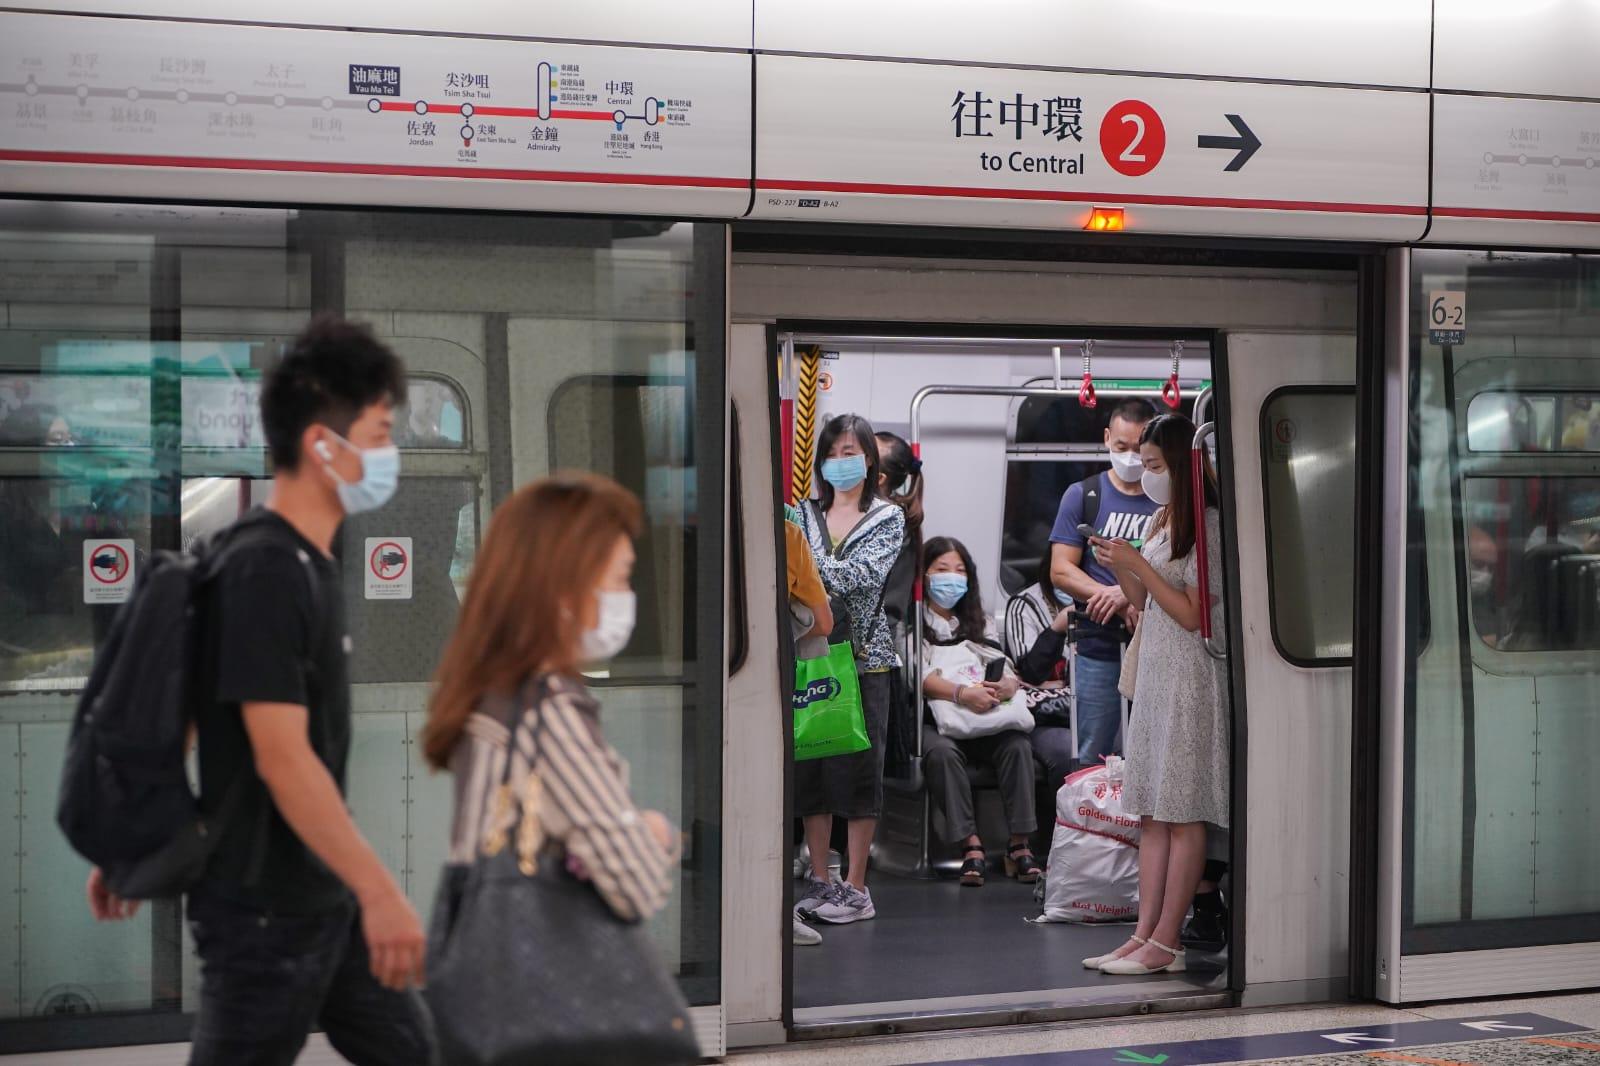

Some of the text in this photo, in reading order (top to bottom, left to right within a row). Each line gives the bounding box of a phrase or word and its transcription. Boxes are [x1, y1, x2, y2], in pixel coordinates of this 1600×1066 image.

[265, 63, 296, 79] 太子
[352, 67, 398, 85] 油麻地
[445, 72, 490, 88] 尖沙咀
[605, 80, 634, 95] 中環
[355, 85, 394, 94] Yau Ma Tei
[462, 90, 475, 98] Sha
[476, 91, 491, 99] Tsui
[607, 97, 632, 105] Central
[951, 90, 1083, 143] 往中環
[407, 120, 436, 136] 佐敦
[478, 124, 497, 135] 尖東
[530, 126, 559, 141] 金鐘
[409, 138, 434, 146] Jordan
[644, 131, 660, 142] 香港
[1118, 113, 1146, 162] 2
[528, 143, 561, 152] Admiralty
[980, 151, 1084, 175] to Central
[1431, 296, 1463, 325] 6-2
[1078, 806, 1112, 823] Golden
